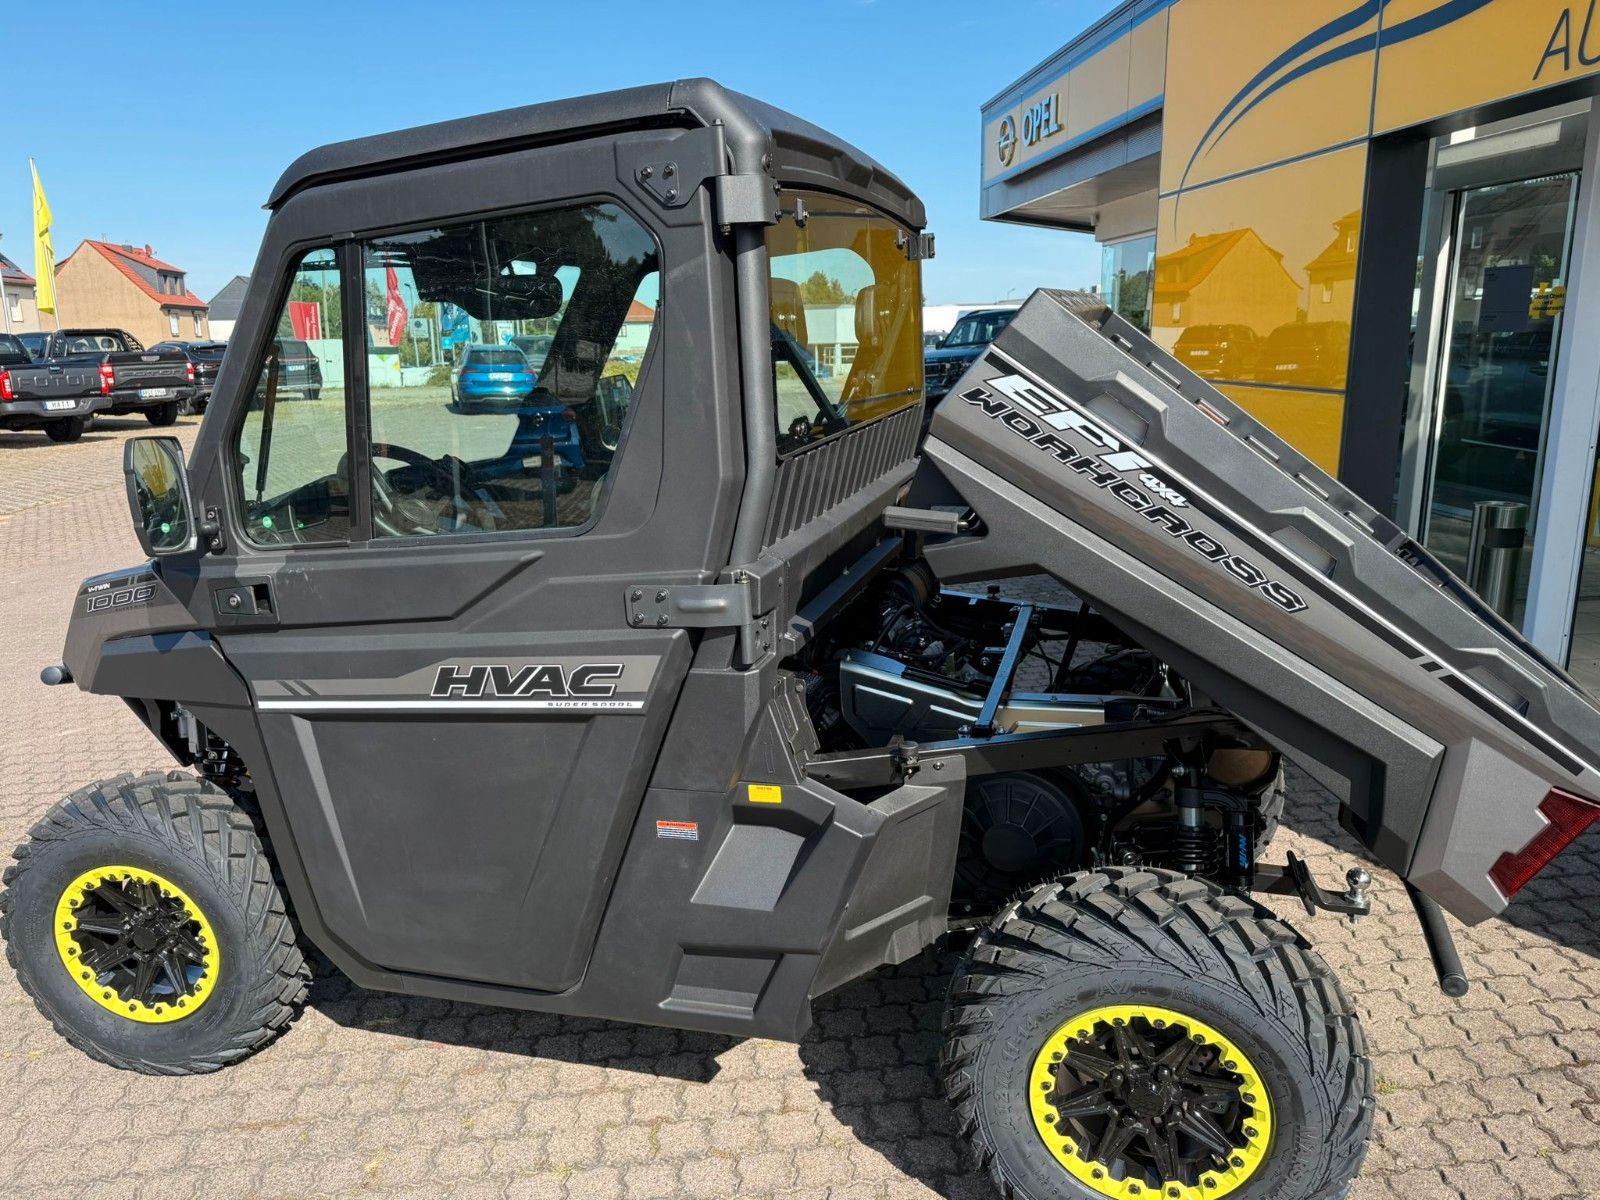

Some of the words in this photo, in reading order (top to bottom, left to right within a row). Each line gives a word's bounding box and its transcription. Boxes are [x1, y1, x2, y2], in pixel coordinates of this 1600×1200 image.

[1022, 94, 1060, 147] OPEL
[983, 373, 1157, 472] EFI
[87, 583, 156, 613] 1000
[430, 663, 625, 698] HVAC
